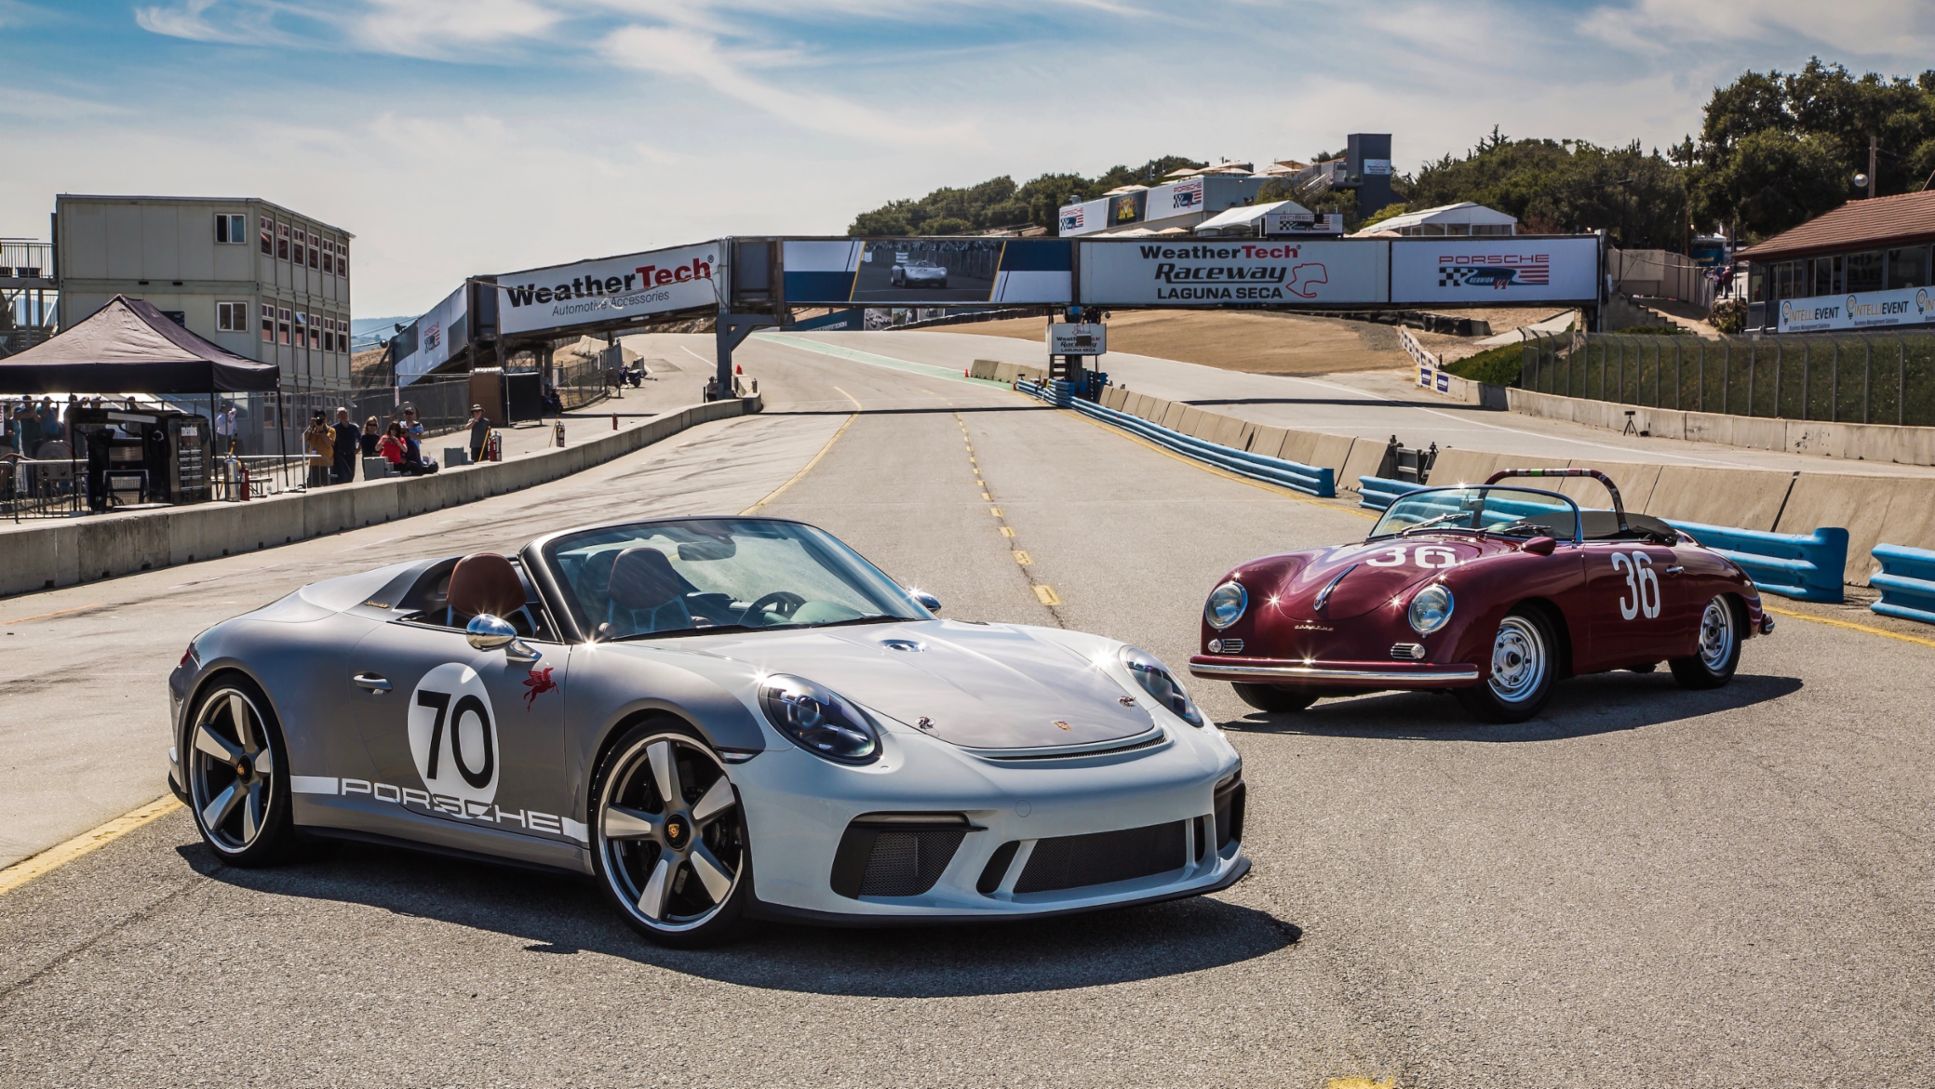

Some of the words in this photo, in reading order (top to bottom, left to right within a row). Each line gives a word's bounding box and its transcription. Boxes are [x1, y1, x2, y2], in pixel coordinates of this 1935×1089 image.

[1439, 254, 1549, 265] PORSCHE
[1154, 263, 1287, 284] Raceway
[610, 290, 670, 309] Accessories
[1157, 287, 1232, 300] LAGUNA
[1236, 287, 1283, 300] SECA
[552, 301, 608, 317] Automotive
[1366, 546, 1457, 569] 36
[1611, 550, 1661, 621] 36
[417, 689, 494, 789] 70
[341, 777, 563, 835] PORSCHE
